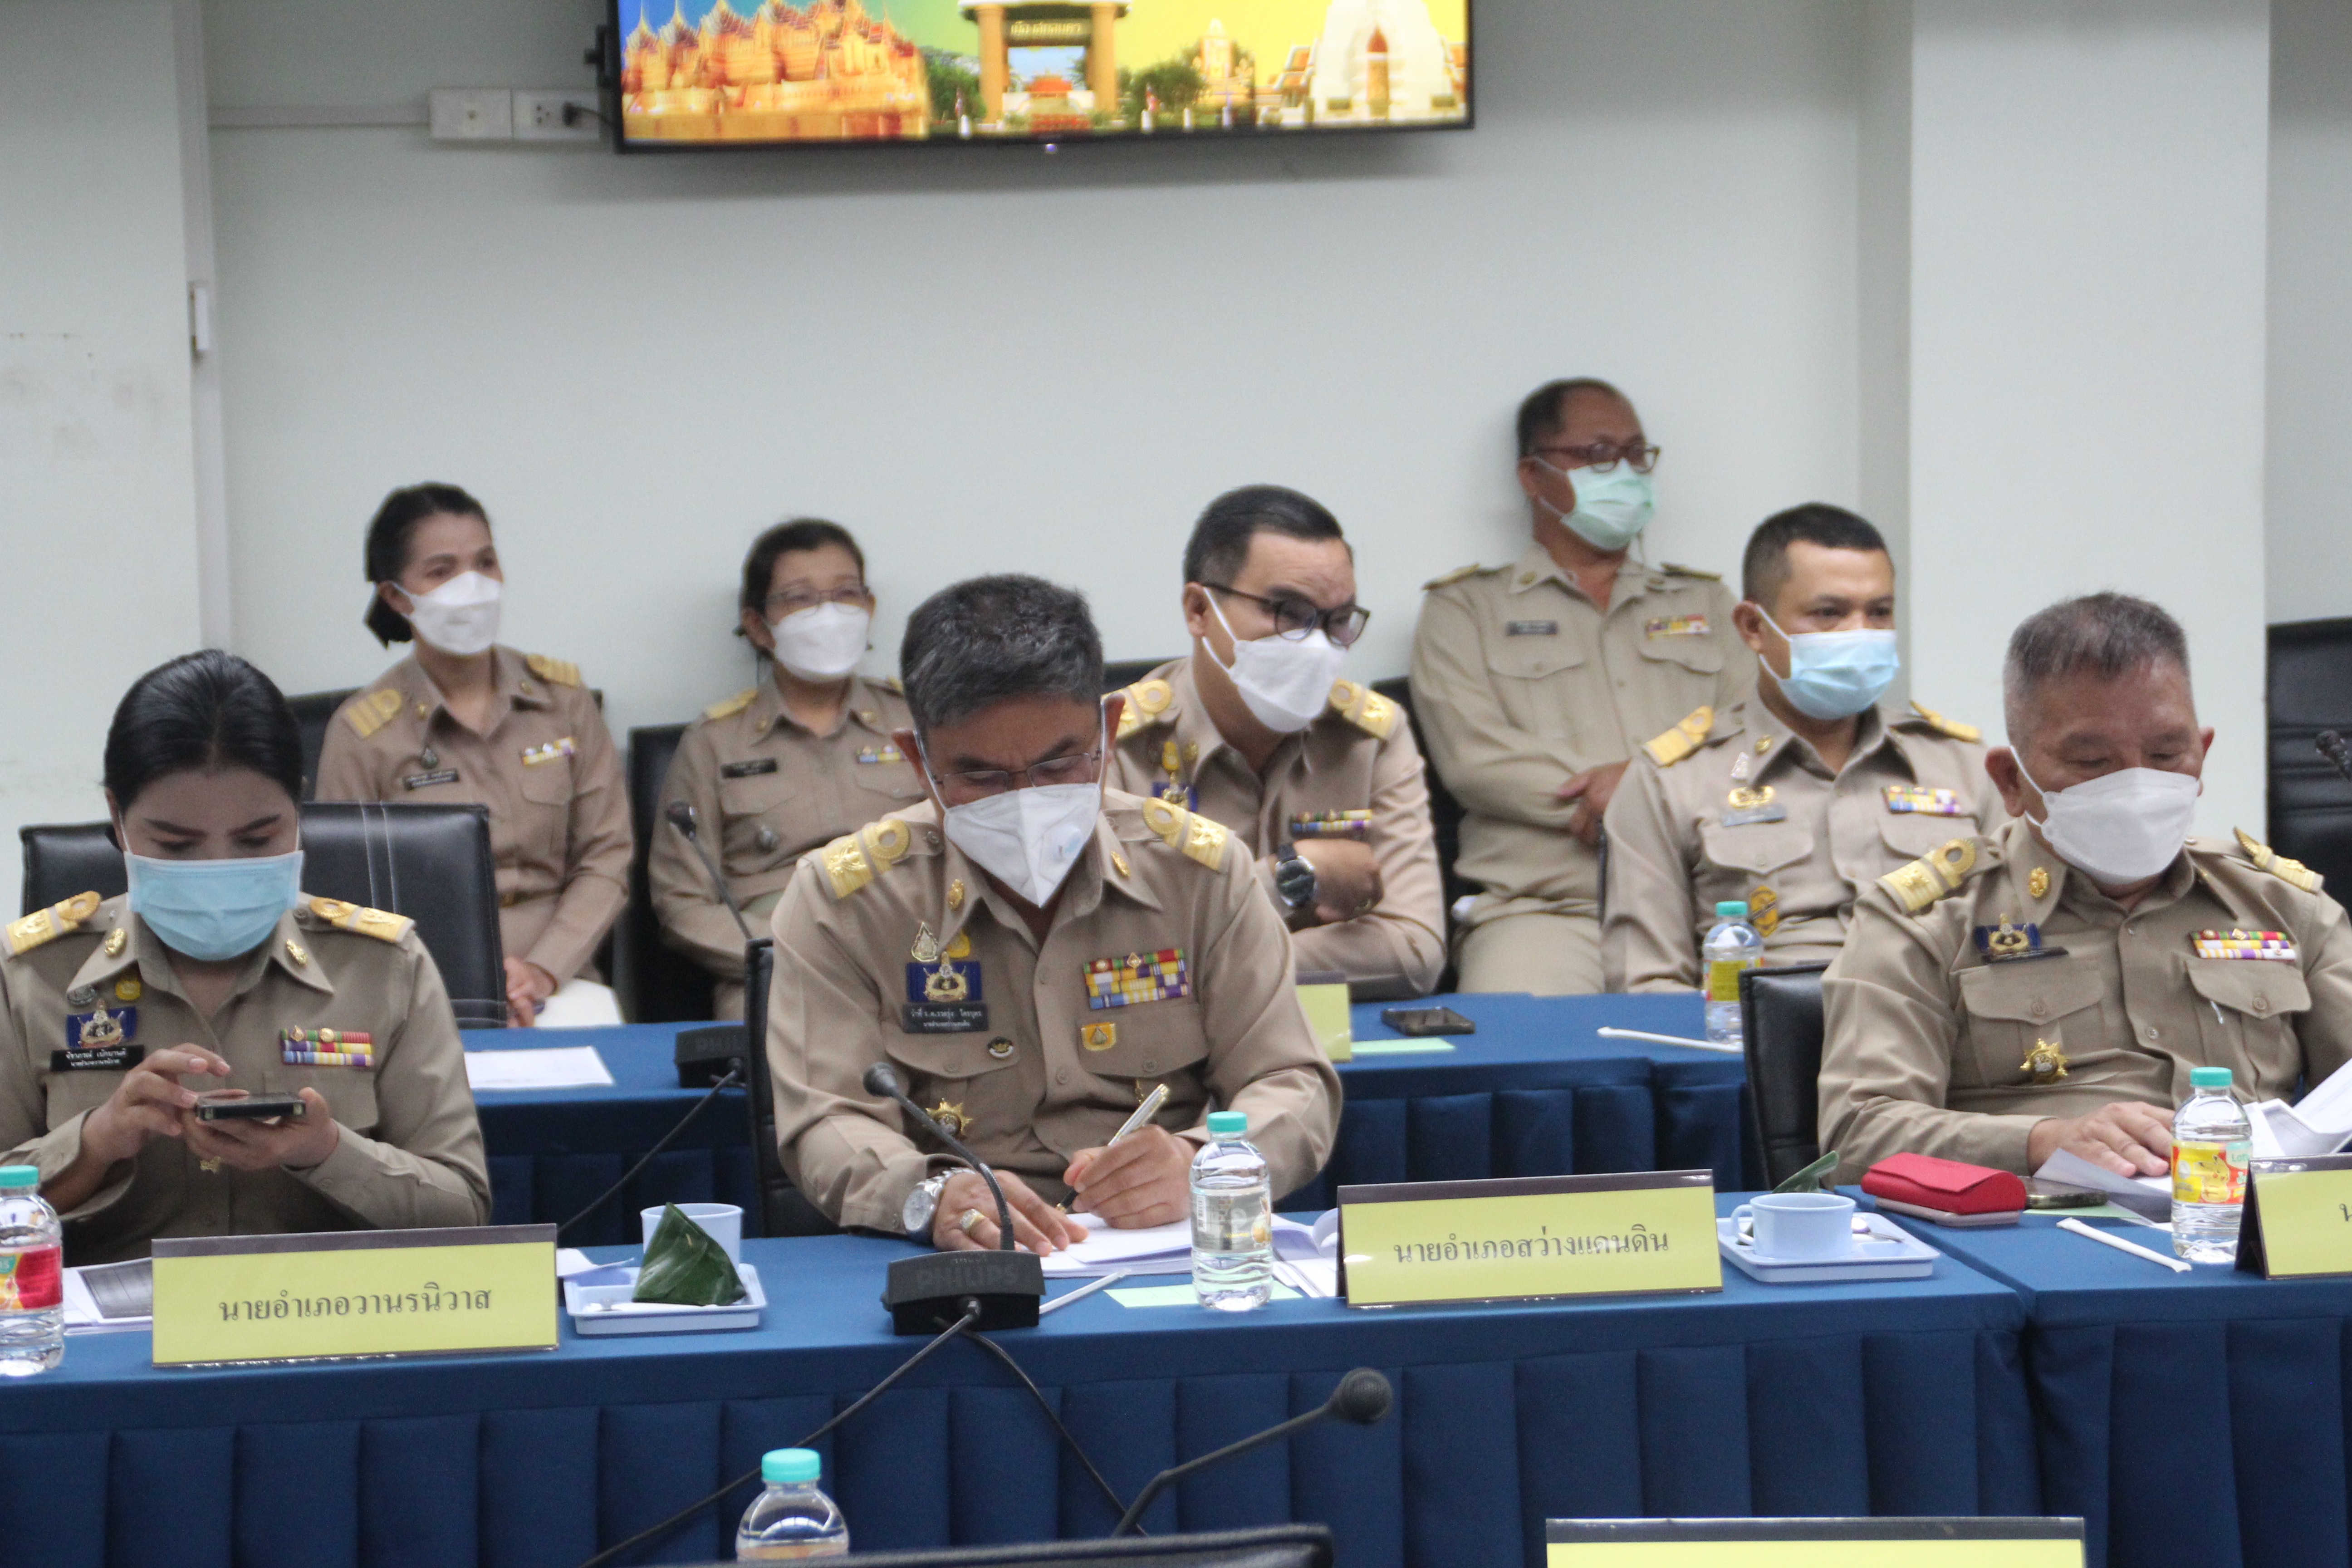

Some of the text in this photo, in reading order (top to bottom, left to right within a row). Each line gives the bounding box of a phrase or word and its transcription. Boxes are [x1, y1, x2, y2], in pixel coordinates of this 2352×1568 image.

[1393, 1224, 1668, 1263] นายอำเภอสว่างแดนดิน
[219, 1281, 492, 1321] นายอำเภอวานรนิวาส
